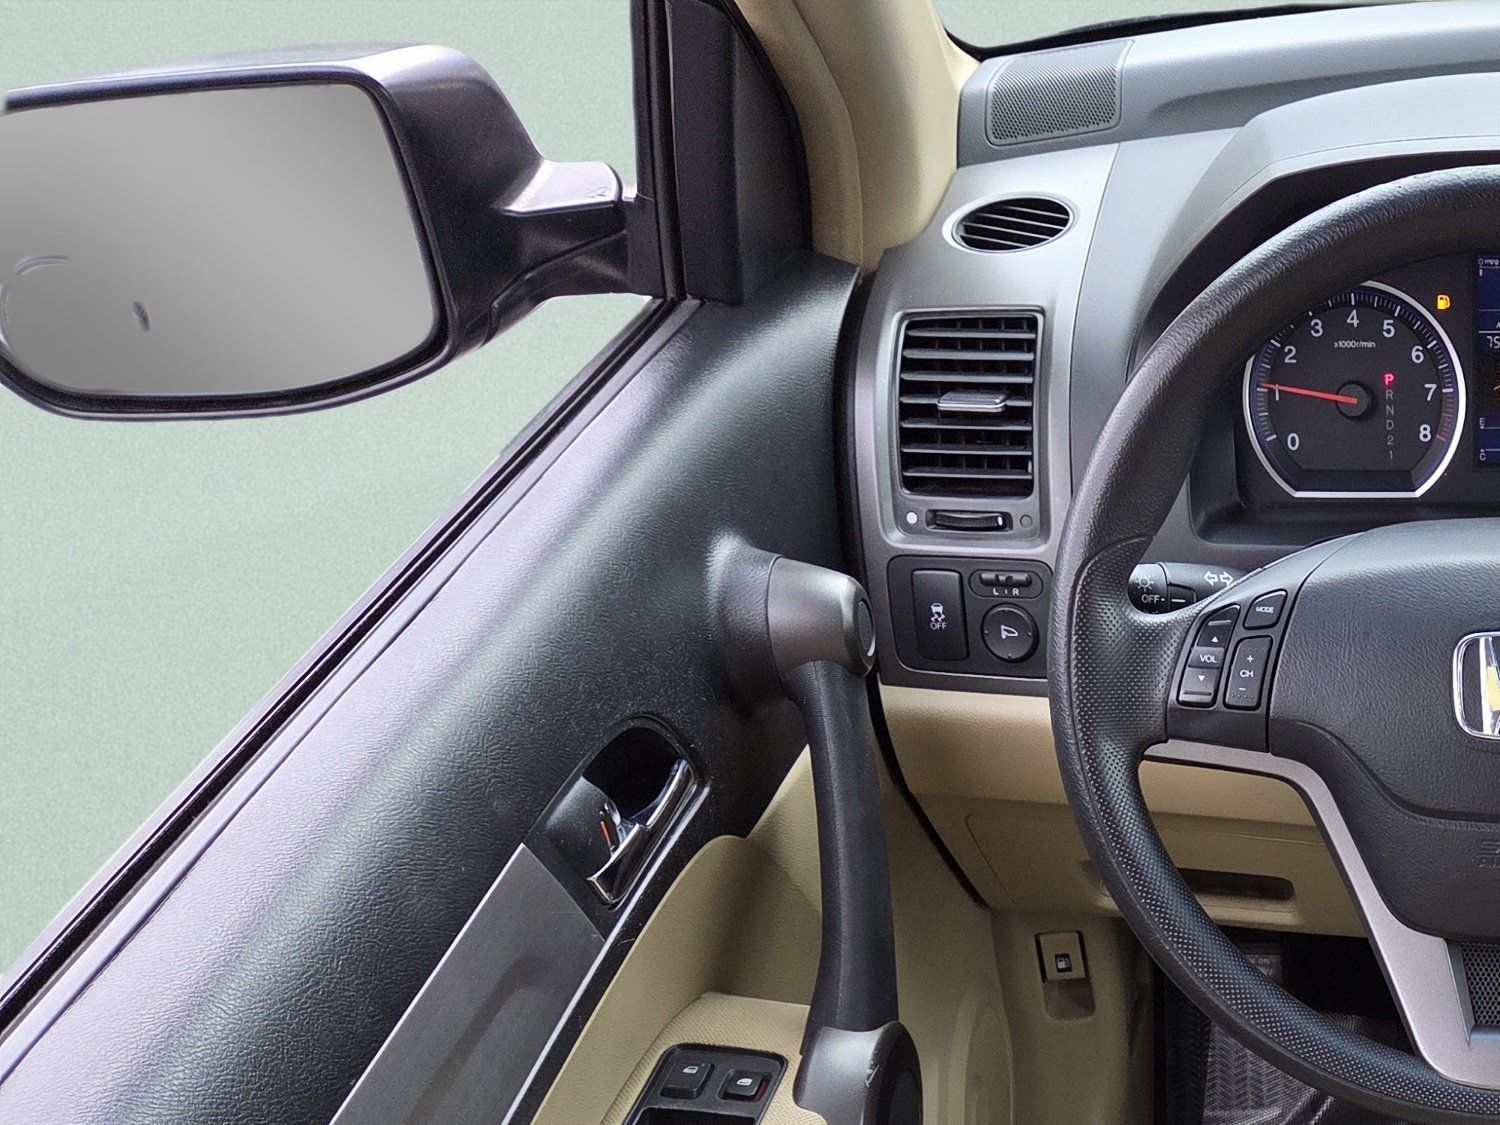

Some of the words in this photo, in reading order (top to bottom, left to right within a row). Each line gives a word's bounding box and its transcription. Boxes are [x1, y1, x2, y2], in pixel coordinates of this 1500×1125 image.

[1346, 308, 1360, 329] 4
[1310, 318, 1324, 338] 3
[1382, 319, 1396, 338] 5
[1283, 345, 1298, 364] 2
[1411, 345, 1425, 364] 6
[1384, 372, 1396, 386] P
[1385, 390, 1395, 400] R
[1424, 383, 1438, 402] 7
[1385, 404, 1395, 415] N
[1385, 419, 1395, 431] D
[1418, 423, 1432, 443] 8
[1287, 432, 1301, 451] 0
[1386, 435, 1395, 446] 2
[1388, 450, 1394, 460] 1
[992, 587, 999, 596] L
[1012, 587, 1020, 596] R
[1141, 594, 1161, 604] OFF
[1256, 606, 1275, 614] MODE
[930, 622, 948, 631] OFF
[1199, 654, 1218, 664] VOL
[1240, 669, 1254, 678] CH
